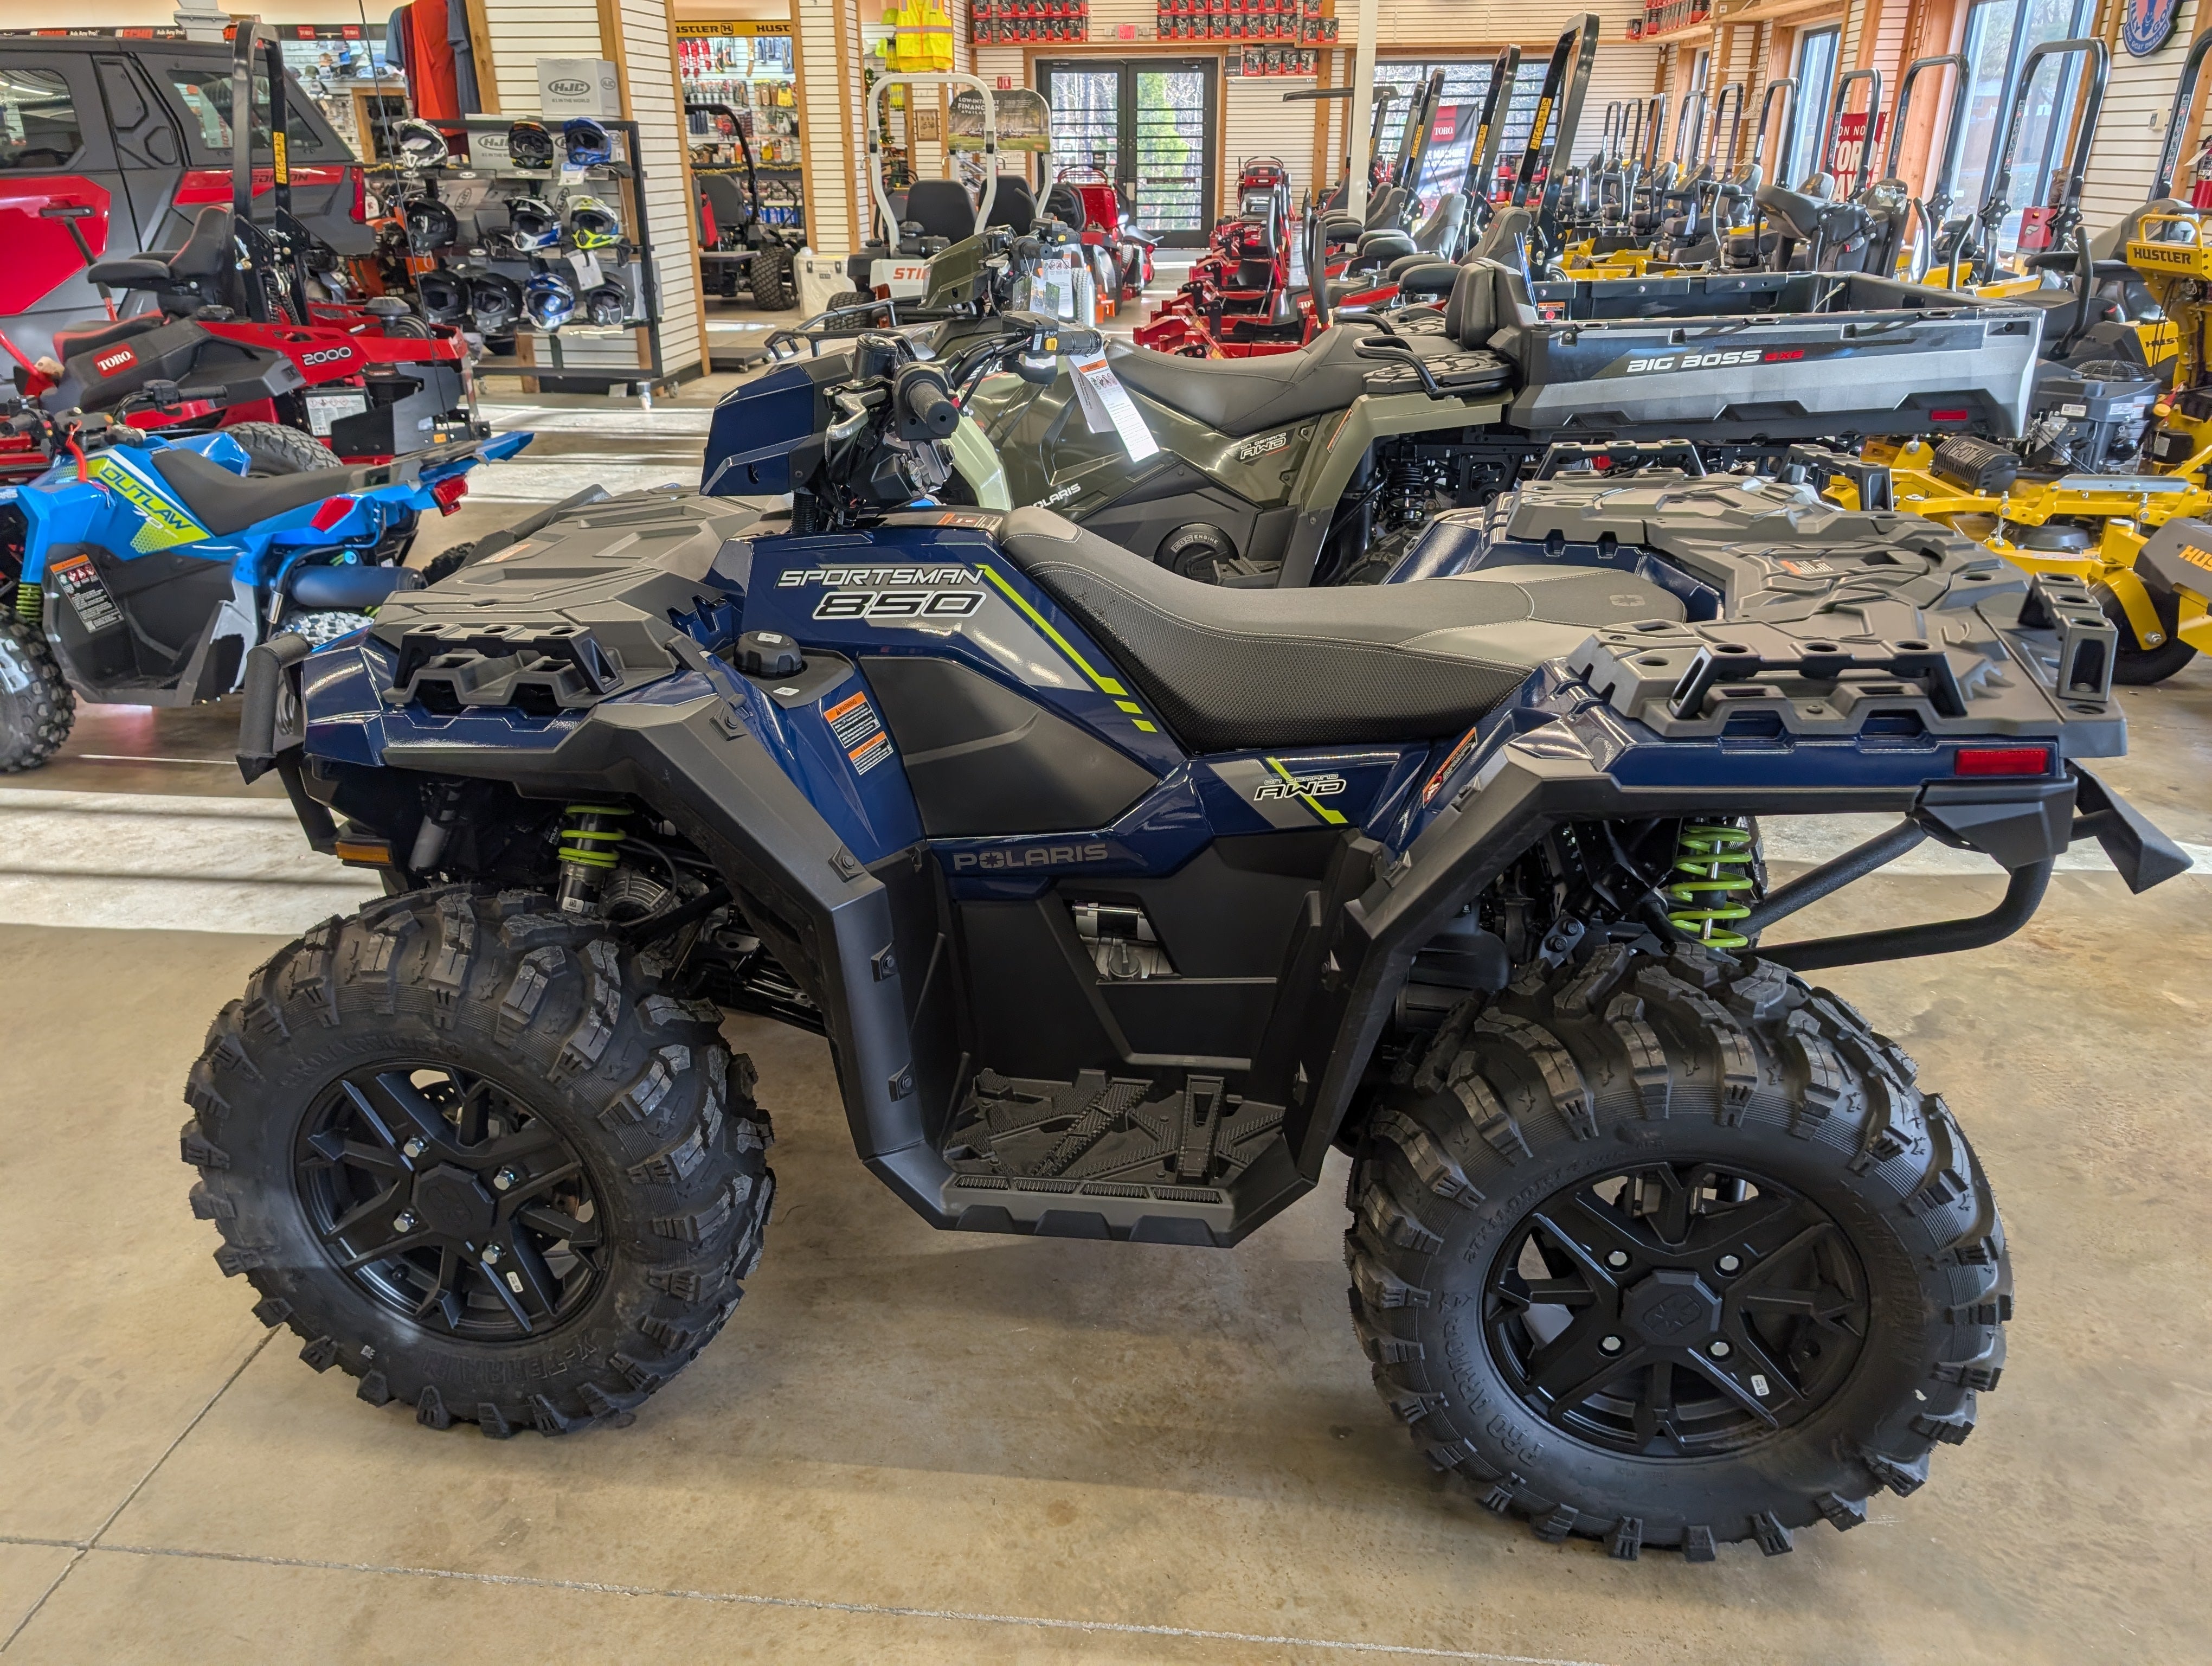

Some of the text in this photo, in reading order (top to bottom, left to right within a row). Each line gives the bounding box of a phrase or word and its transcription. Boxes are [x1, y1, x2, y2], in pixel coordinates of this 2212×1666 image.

[554, 83, 584, 92] HJC
[1434, 126, 1454, 136] TORO
[2133, 247, 2191, 265] HUSTLER
[893, 267, 925, 280] STI
[2145, 336, 2178, 348] HUST
[97, 350, 134, 372] TORO
[302, 346, 352, 367] 2000
[1626, 356, 1676, 373] BIG
[1680, 349, 1763, 368] BOSS
[1253, 432, 1287, 445] DEMAND
[1240, 437, 1287, 460] AWD
[1950, 443, 1979, 460] HOT
[99, 467, 194, 530] OUTLAW
[1032, 483, 1082, 509] OLARIS
[1173, 534, 1219, 551] EBS ENGINE
[776, 567, 985, 587] SPORTSMAN
[812, 590, 987, 620] 850
[838, 699, 857, 713] WARNING
[862, 739, 877, 751] WARNING
[1286, 773, 1340, 784] DEMAND
[1253, 779, 1347, 802] AWD
[953, 843, 1109, 871] POLARIS
